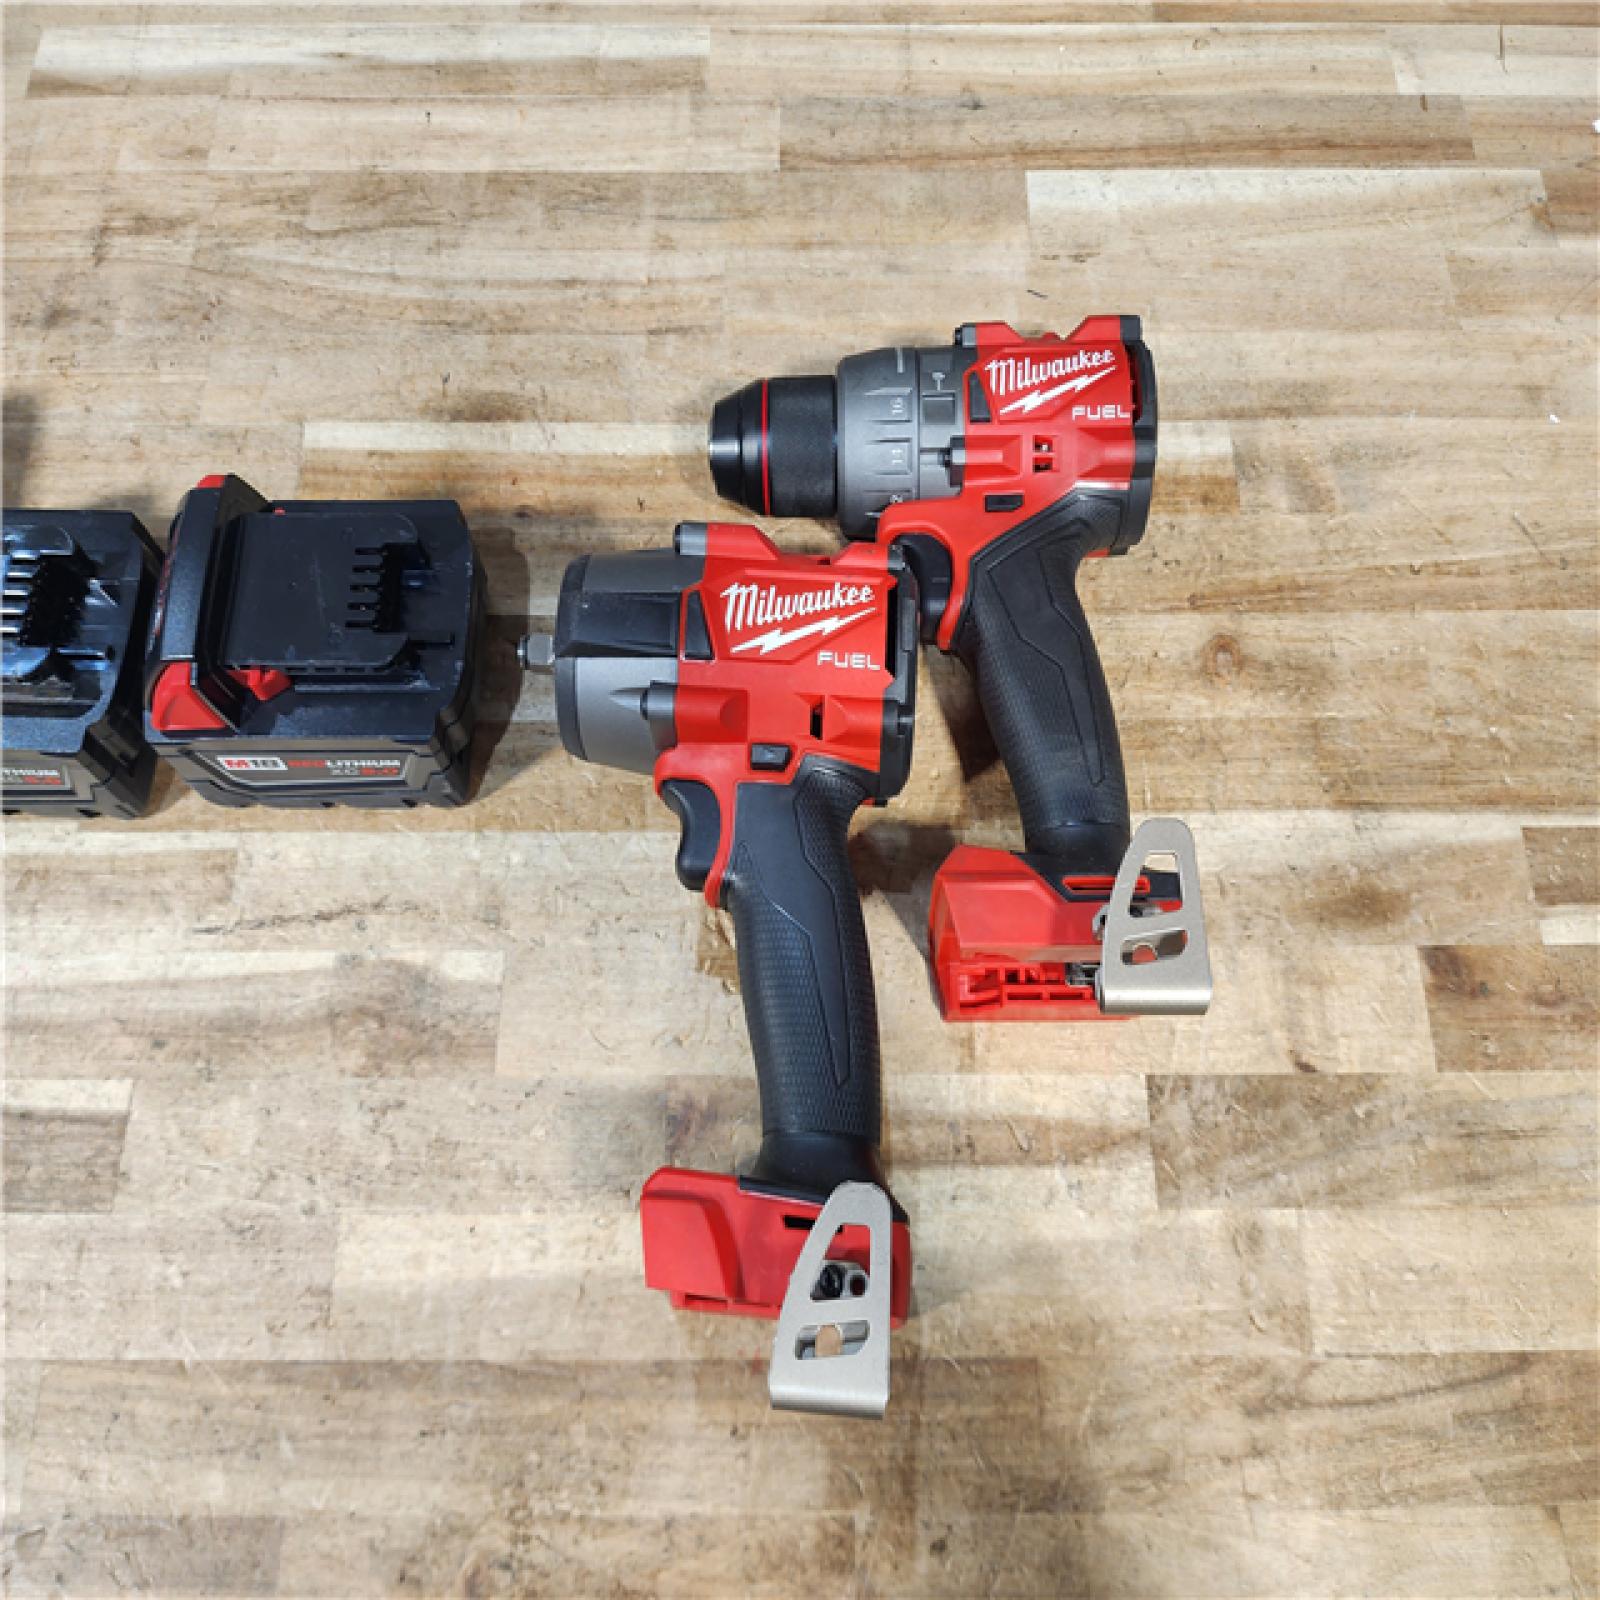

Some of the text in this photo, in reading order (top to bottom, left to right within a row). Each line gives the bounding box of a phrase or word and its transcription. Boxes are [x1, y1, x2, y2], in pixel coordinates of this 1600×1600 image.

[985, 350, 1115, 395] Milwaukee
[1071, 405, 1131, 420] FUEL
[720, 582, 875, 633] Milwaukee
[817, 651, 880, 670] FUEL
